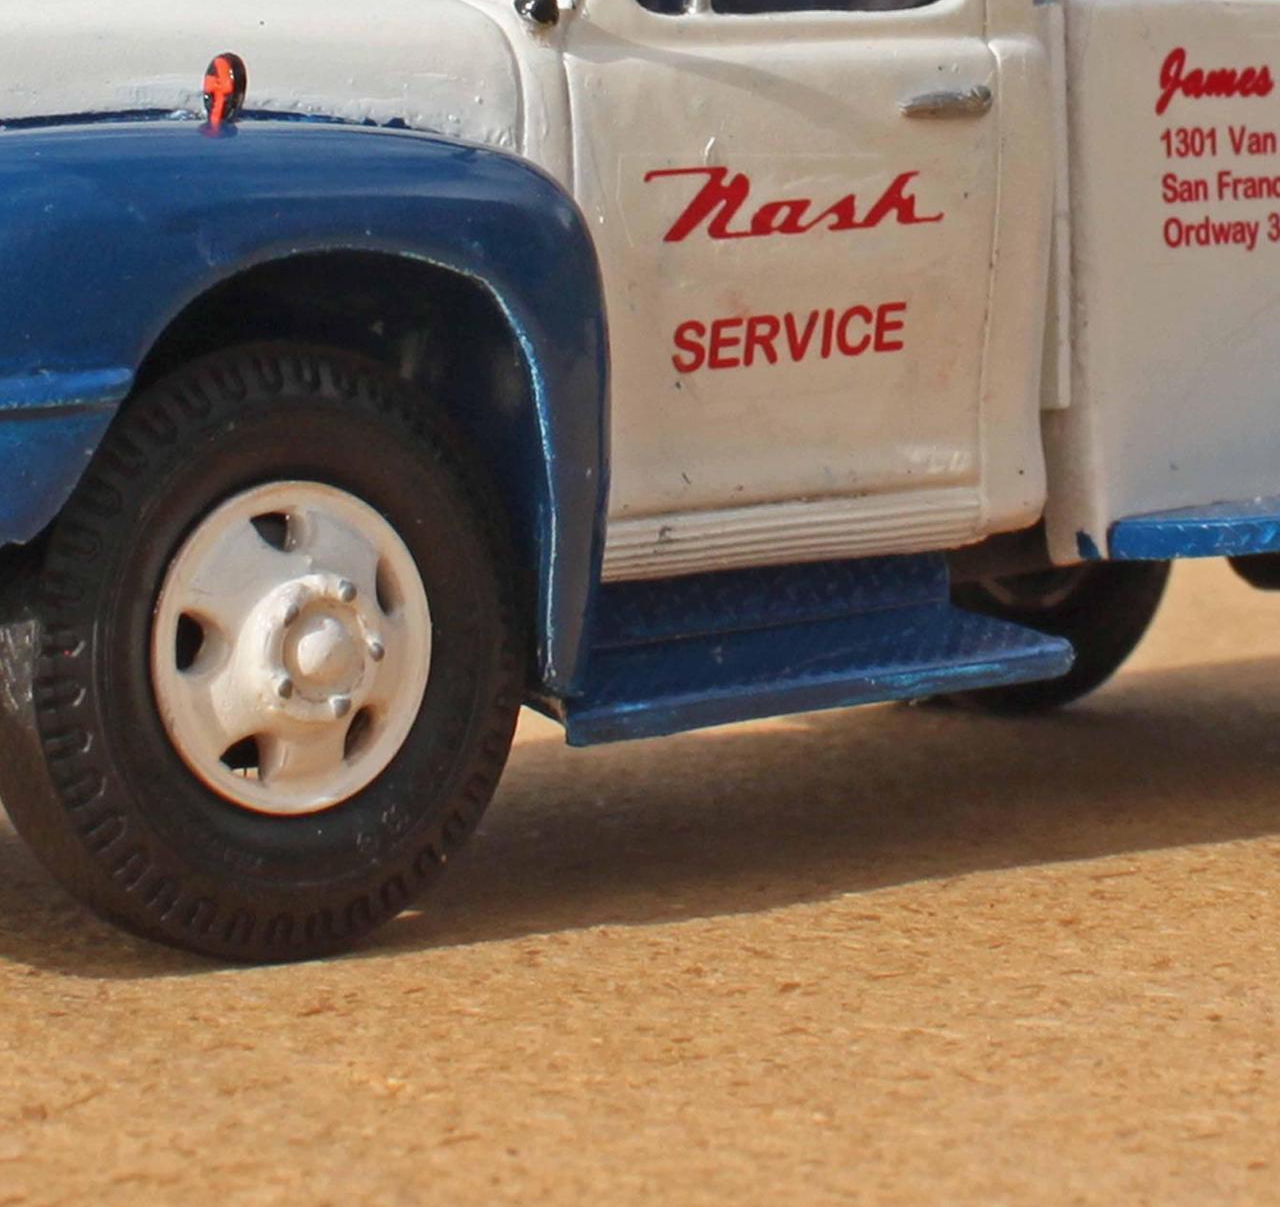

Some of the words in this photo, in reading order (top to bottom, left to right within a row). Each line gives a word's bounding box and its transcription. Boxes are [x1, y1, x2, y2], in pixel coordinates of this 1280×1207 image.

[1155, 46, 1275, 116] James
[1160, 127, 1218, 158] 1301
[1228, 125, 1277, 156] Van
[643, 165, 944, 243] Nash
[1161, 172, 1209, 204] San
[1163, 216, 1259, 251] Ordway
[672, 301, 907, 373] SERVICE
